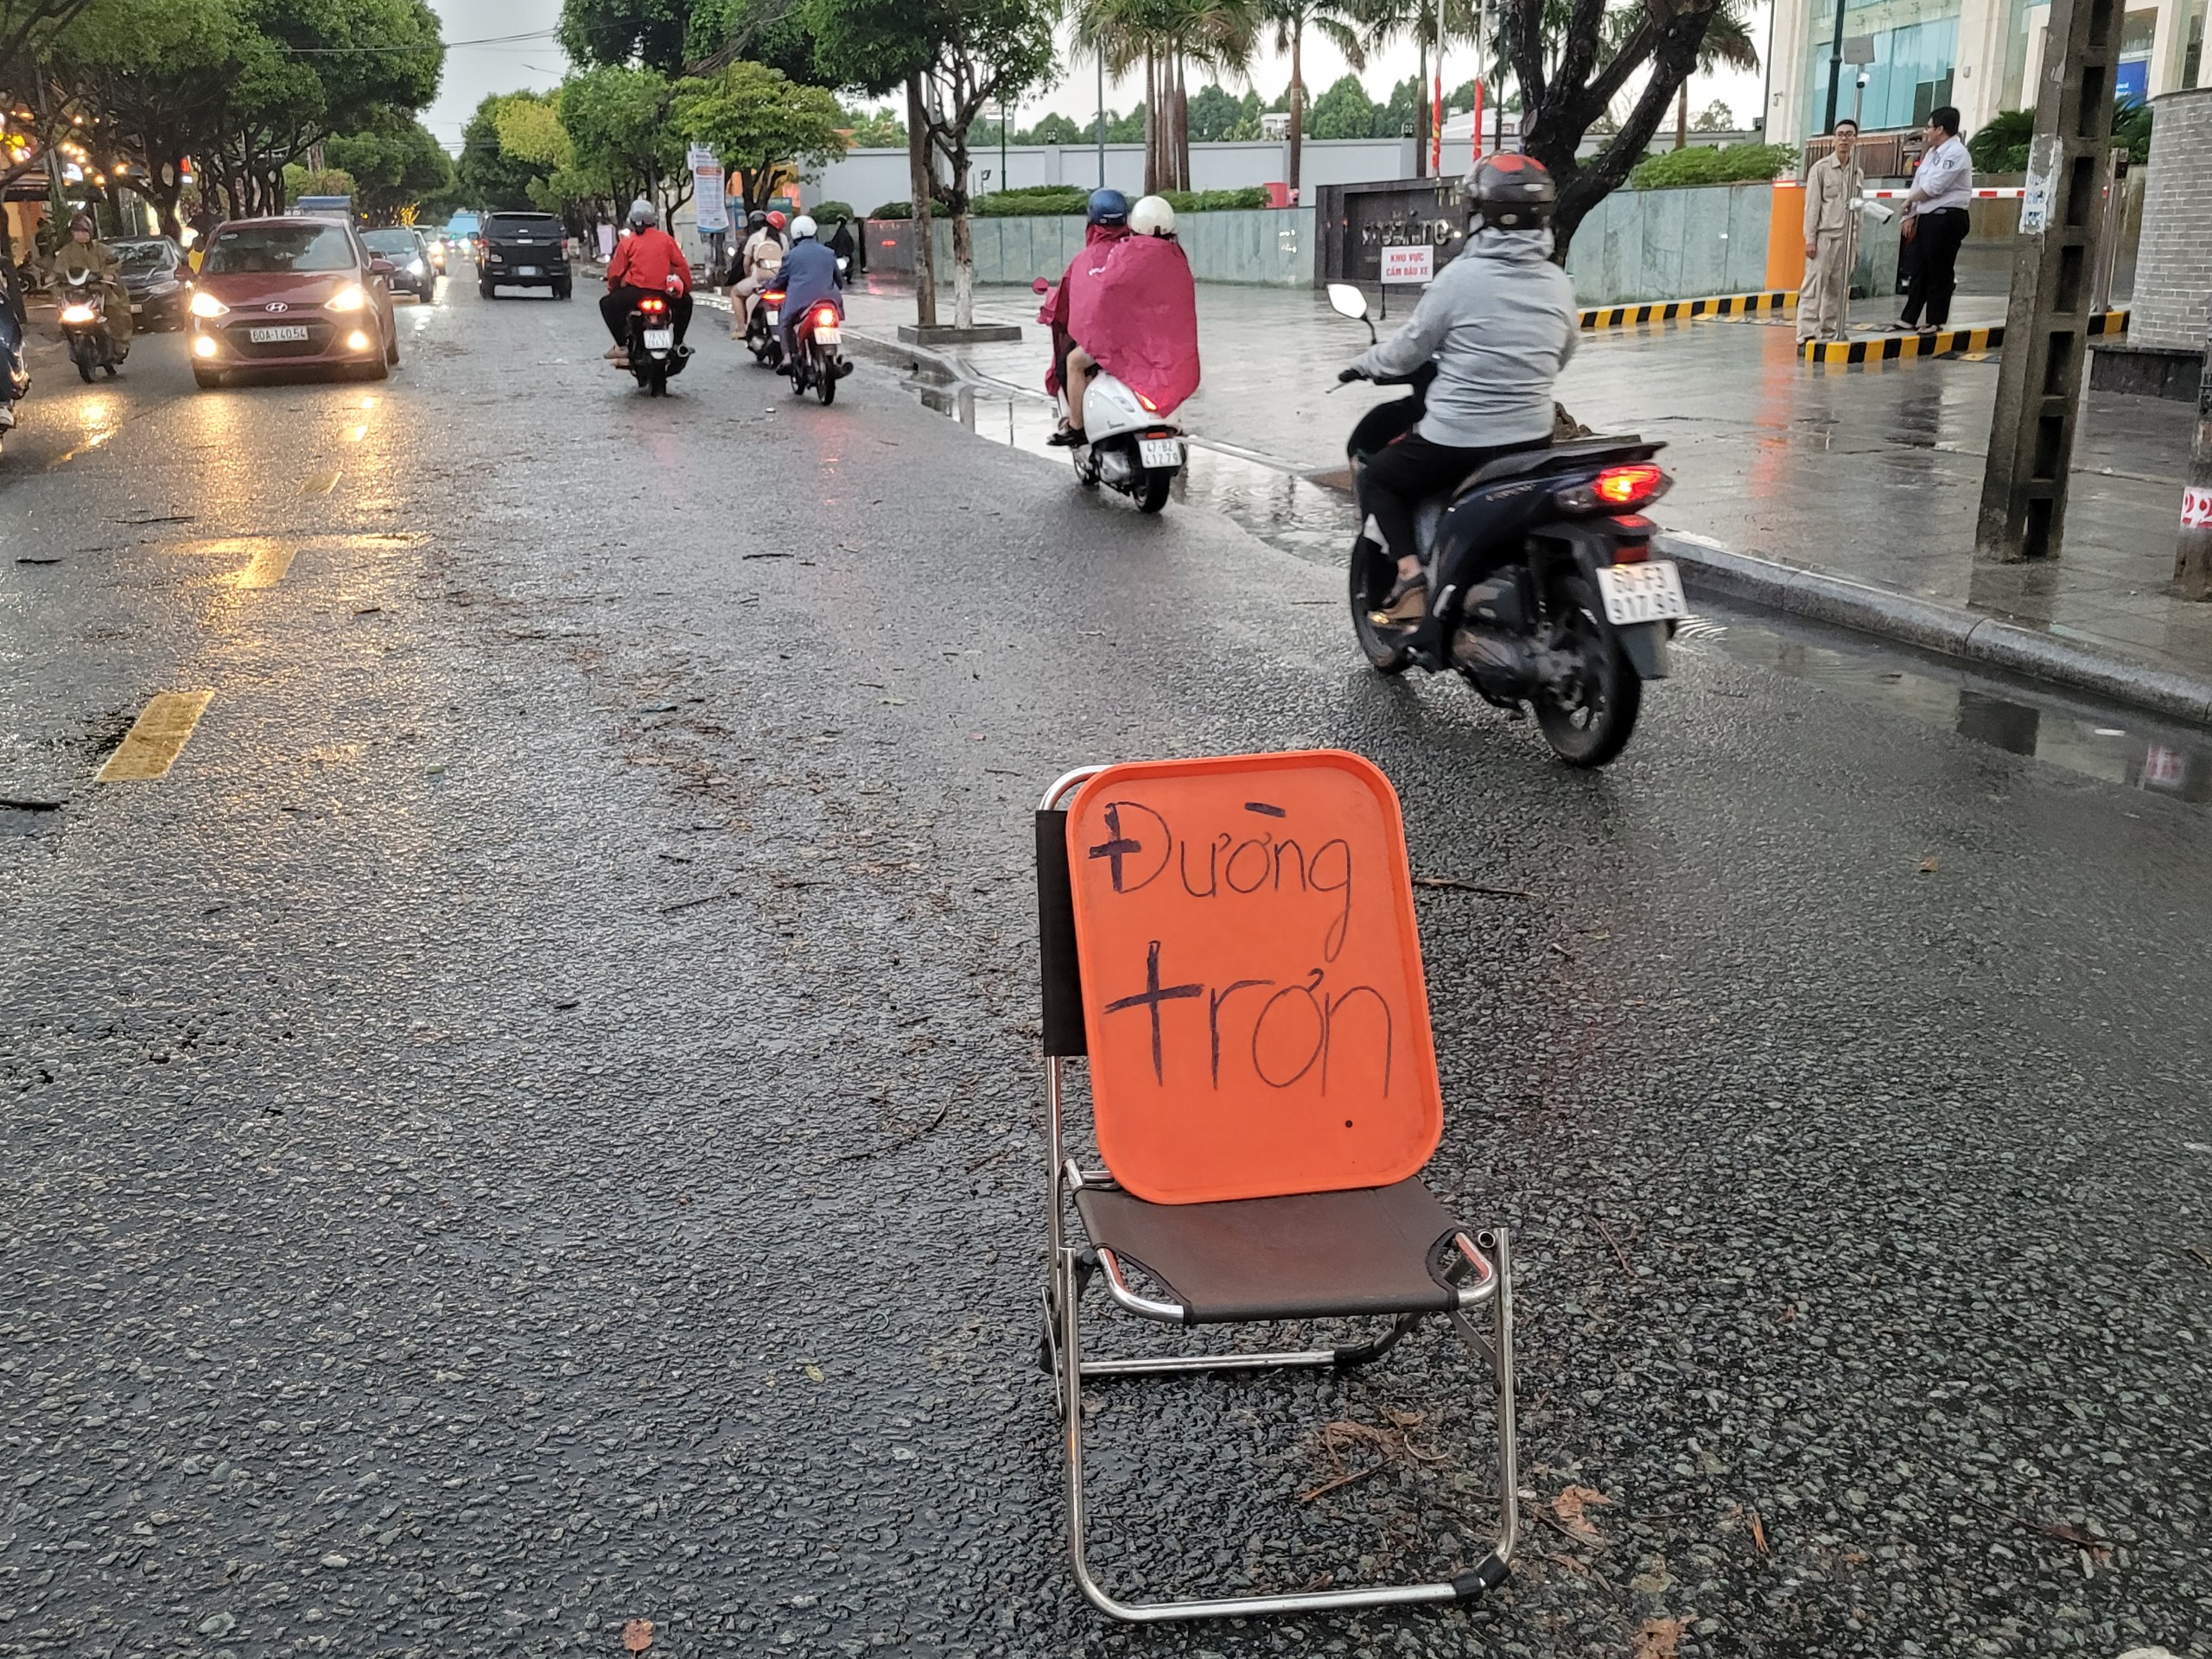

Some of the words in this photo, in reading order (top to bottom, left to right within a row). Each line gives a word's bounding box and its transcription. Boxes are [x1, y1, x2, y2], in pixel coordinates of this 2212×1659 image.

[1390, 253, 1407, 263] KHU
[1088, 801, 1352, 963] Đường
[1103, 940, 1393, 1098] trơn
